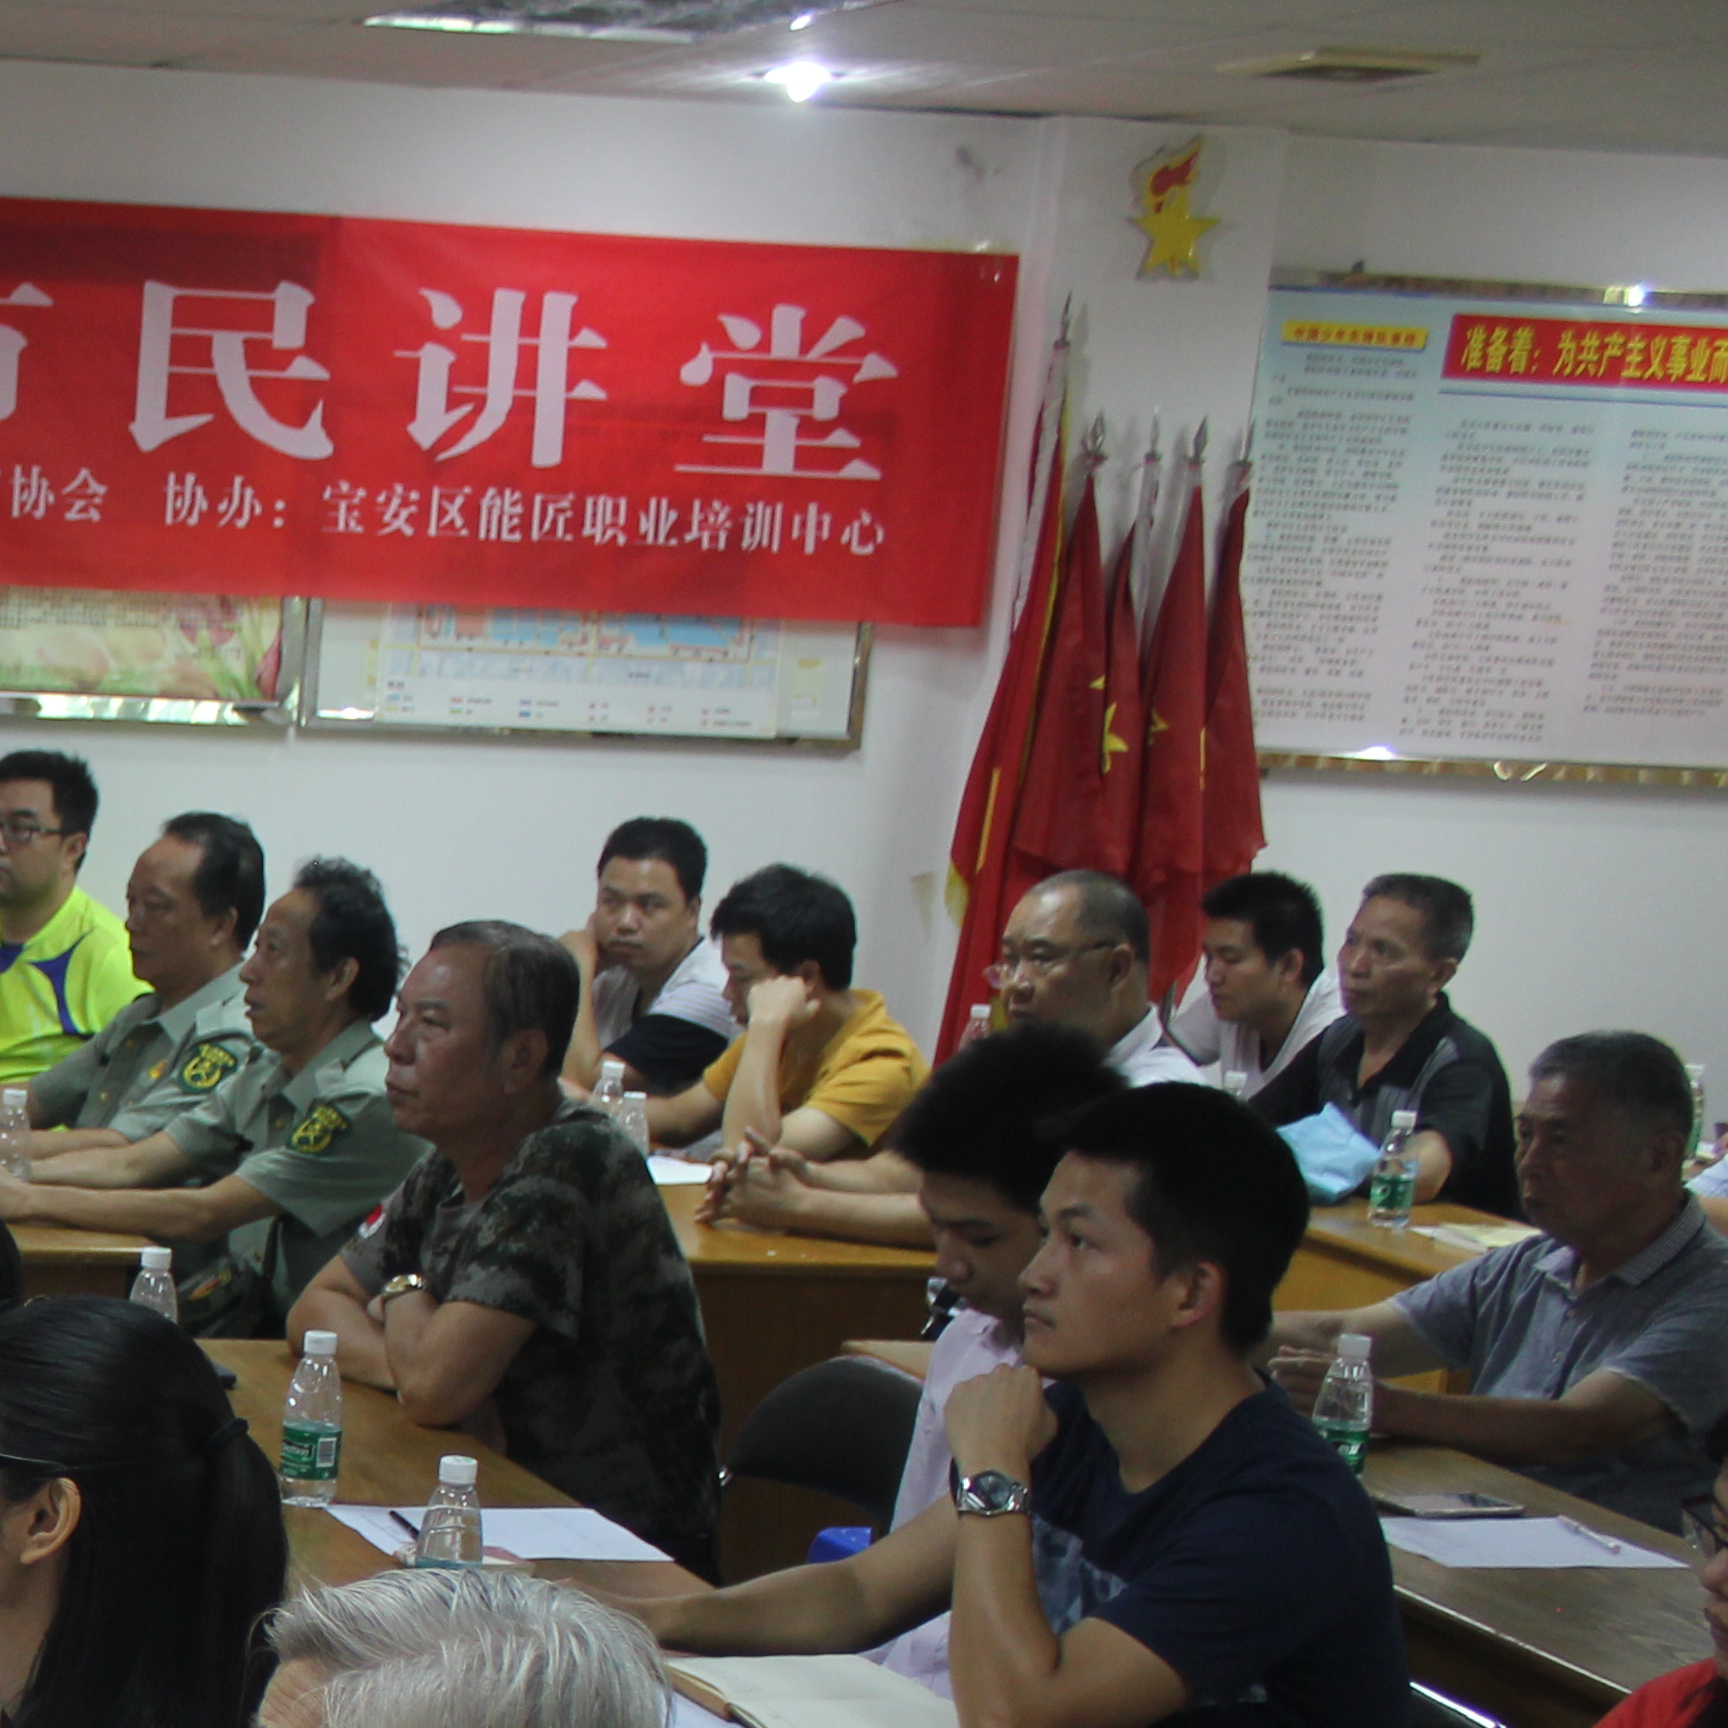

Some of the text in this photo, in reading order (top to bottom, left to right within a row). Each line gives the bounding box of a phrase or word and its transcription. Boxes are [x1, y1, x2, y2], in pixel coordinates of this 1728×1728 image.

[163, 471, 885, 556] 协办：宝安区能匠职业培训中心
